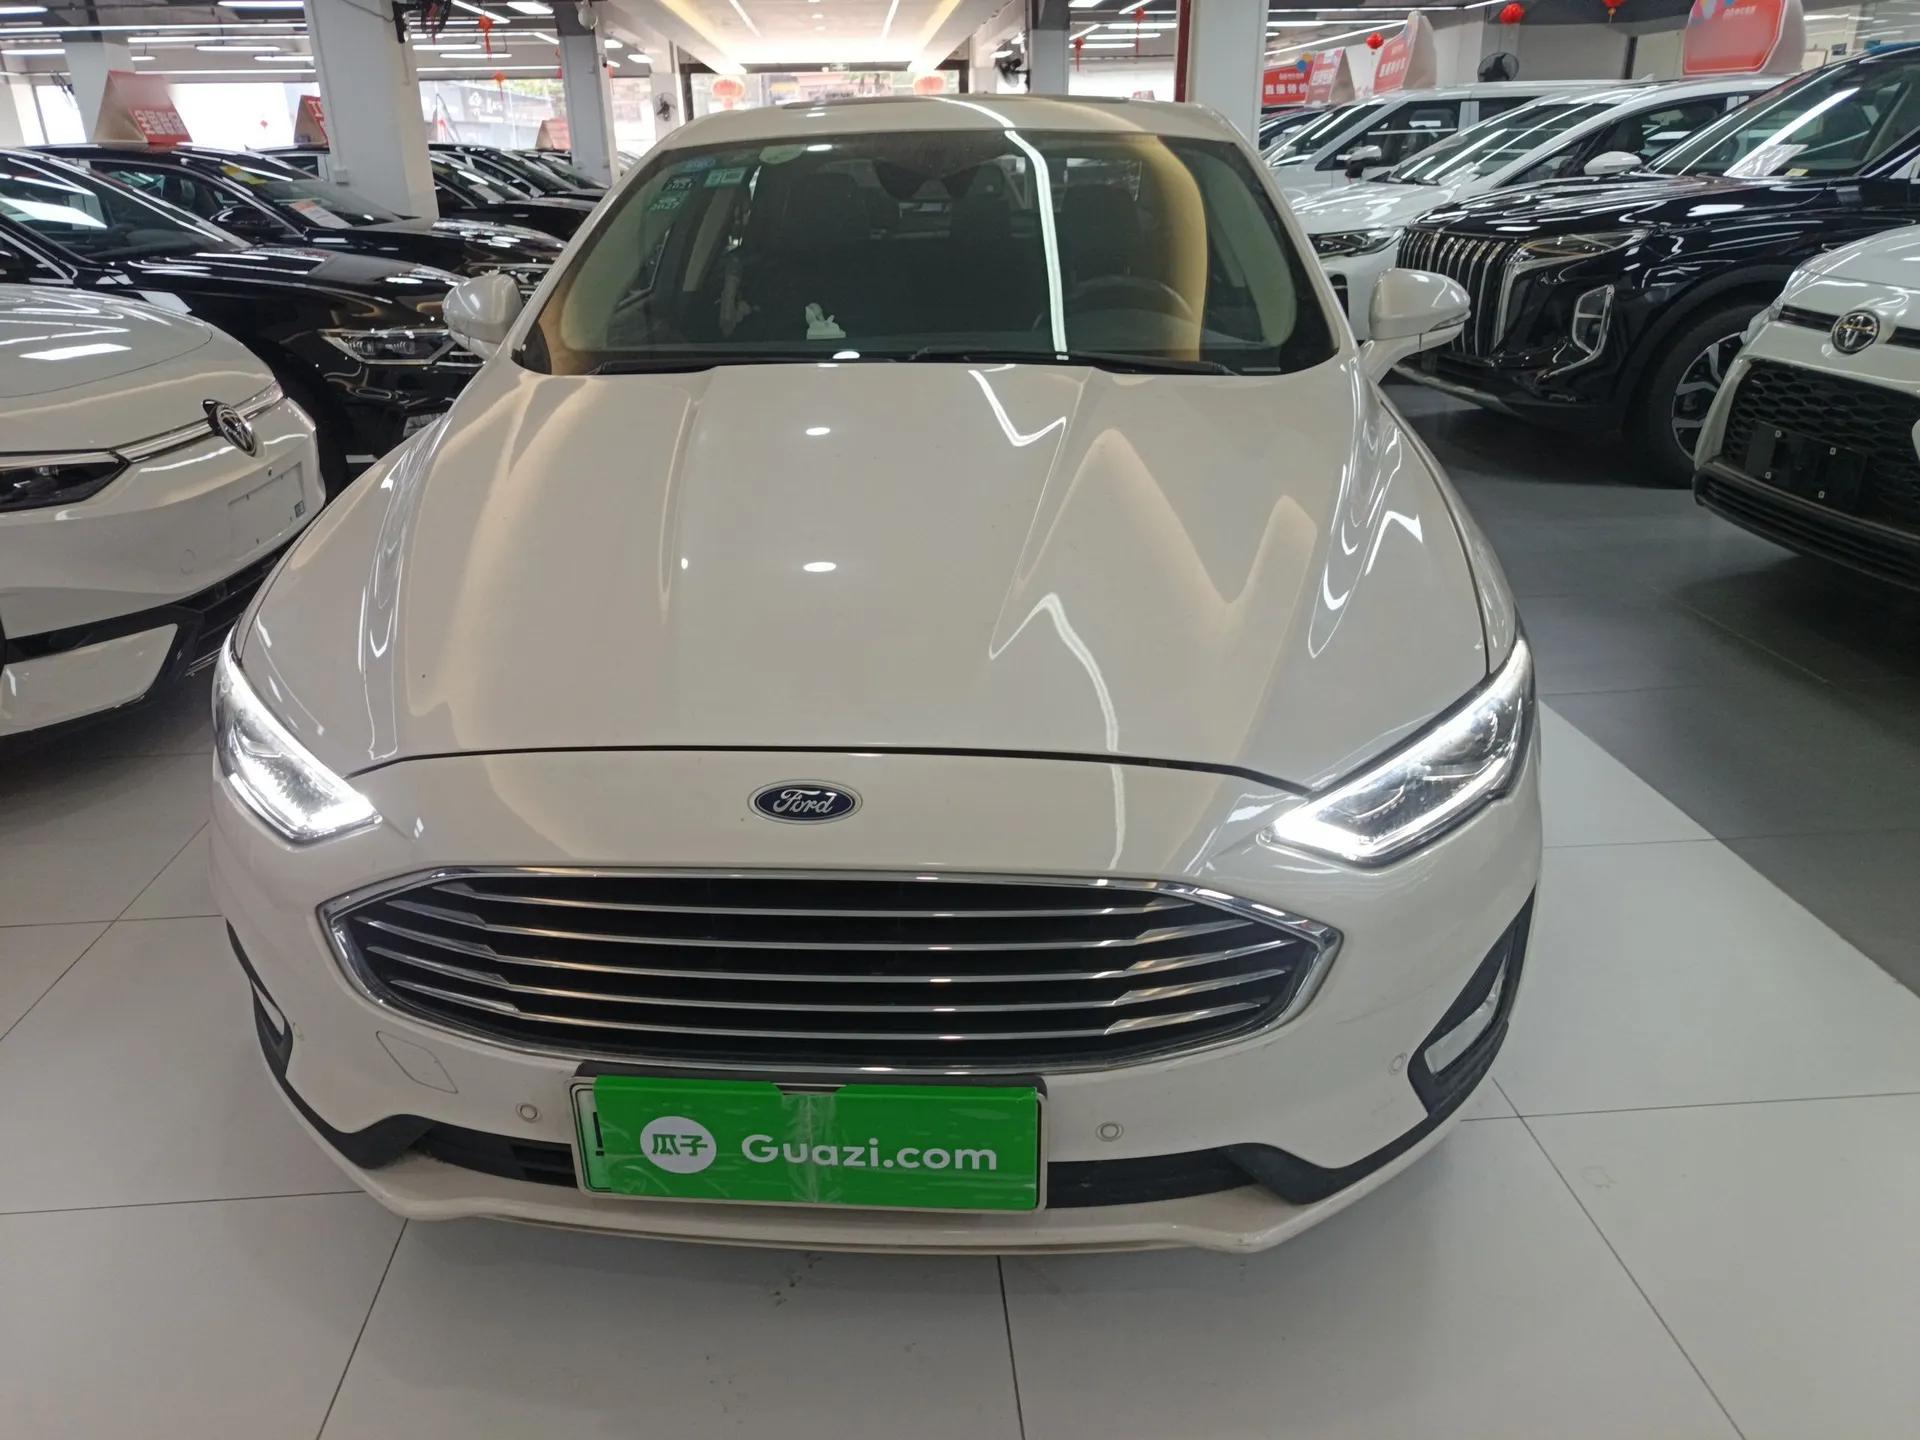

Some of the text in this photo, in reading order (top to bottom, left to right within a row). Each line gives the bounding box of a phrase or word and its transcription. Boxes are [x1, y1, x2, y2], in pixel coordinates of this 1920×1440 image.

[773, 789, 837, 813] Ford
[652, 1133, 997, 1171] 瓜子 Guazi.com
